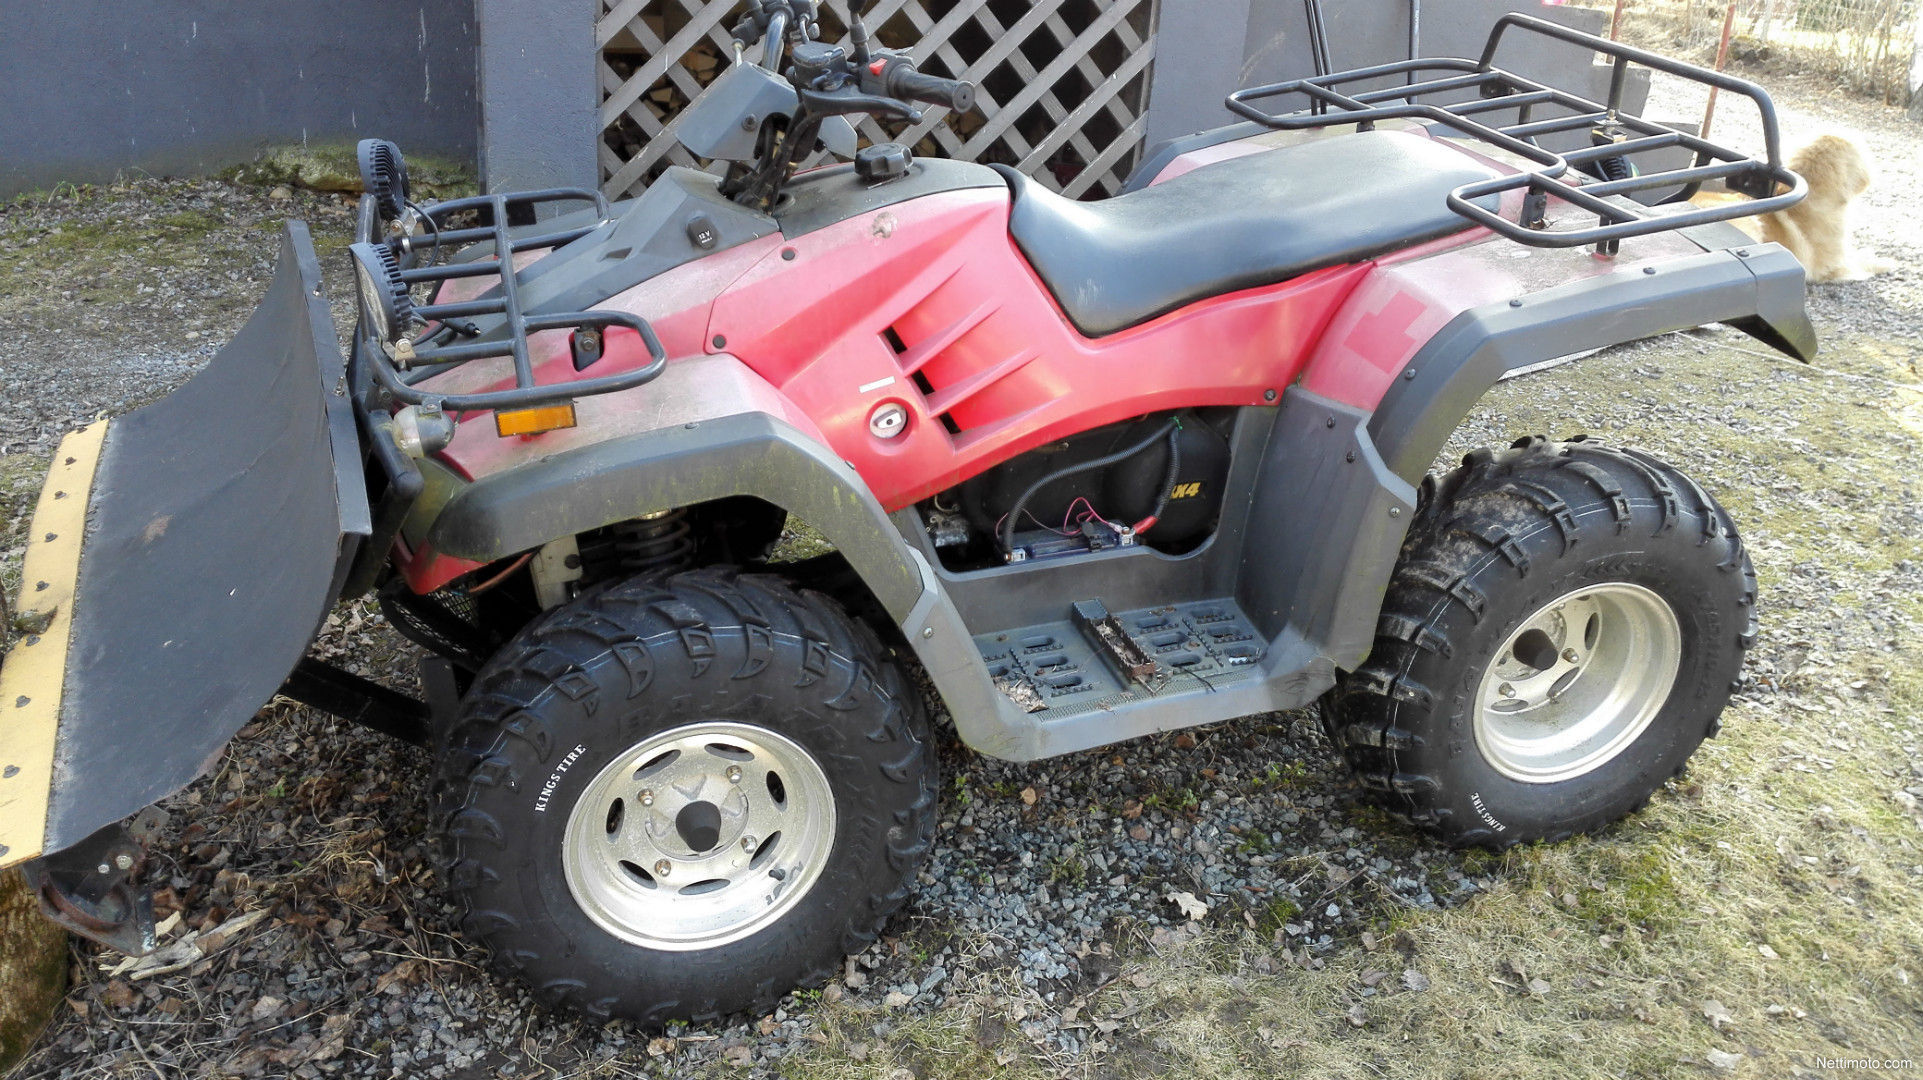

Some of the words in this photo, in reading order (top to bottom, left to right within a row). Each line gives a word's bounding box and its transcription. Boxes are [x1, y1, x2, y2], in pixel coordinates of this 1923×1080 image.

[534, 773, 561, 812] KINGS
[555, 743, 587, 773] TIRE
[1470, 792, 1487, 815] TIRE
[1481, 812, 1506, 832] KINGS
